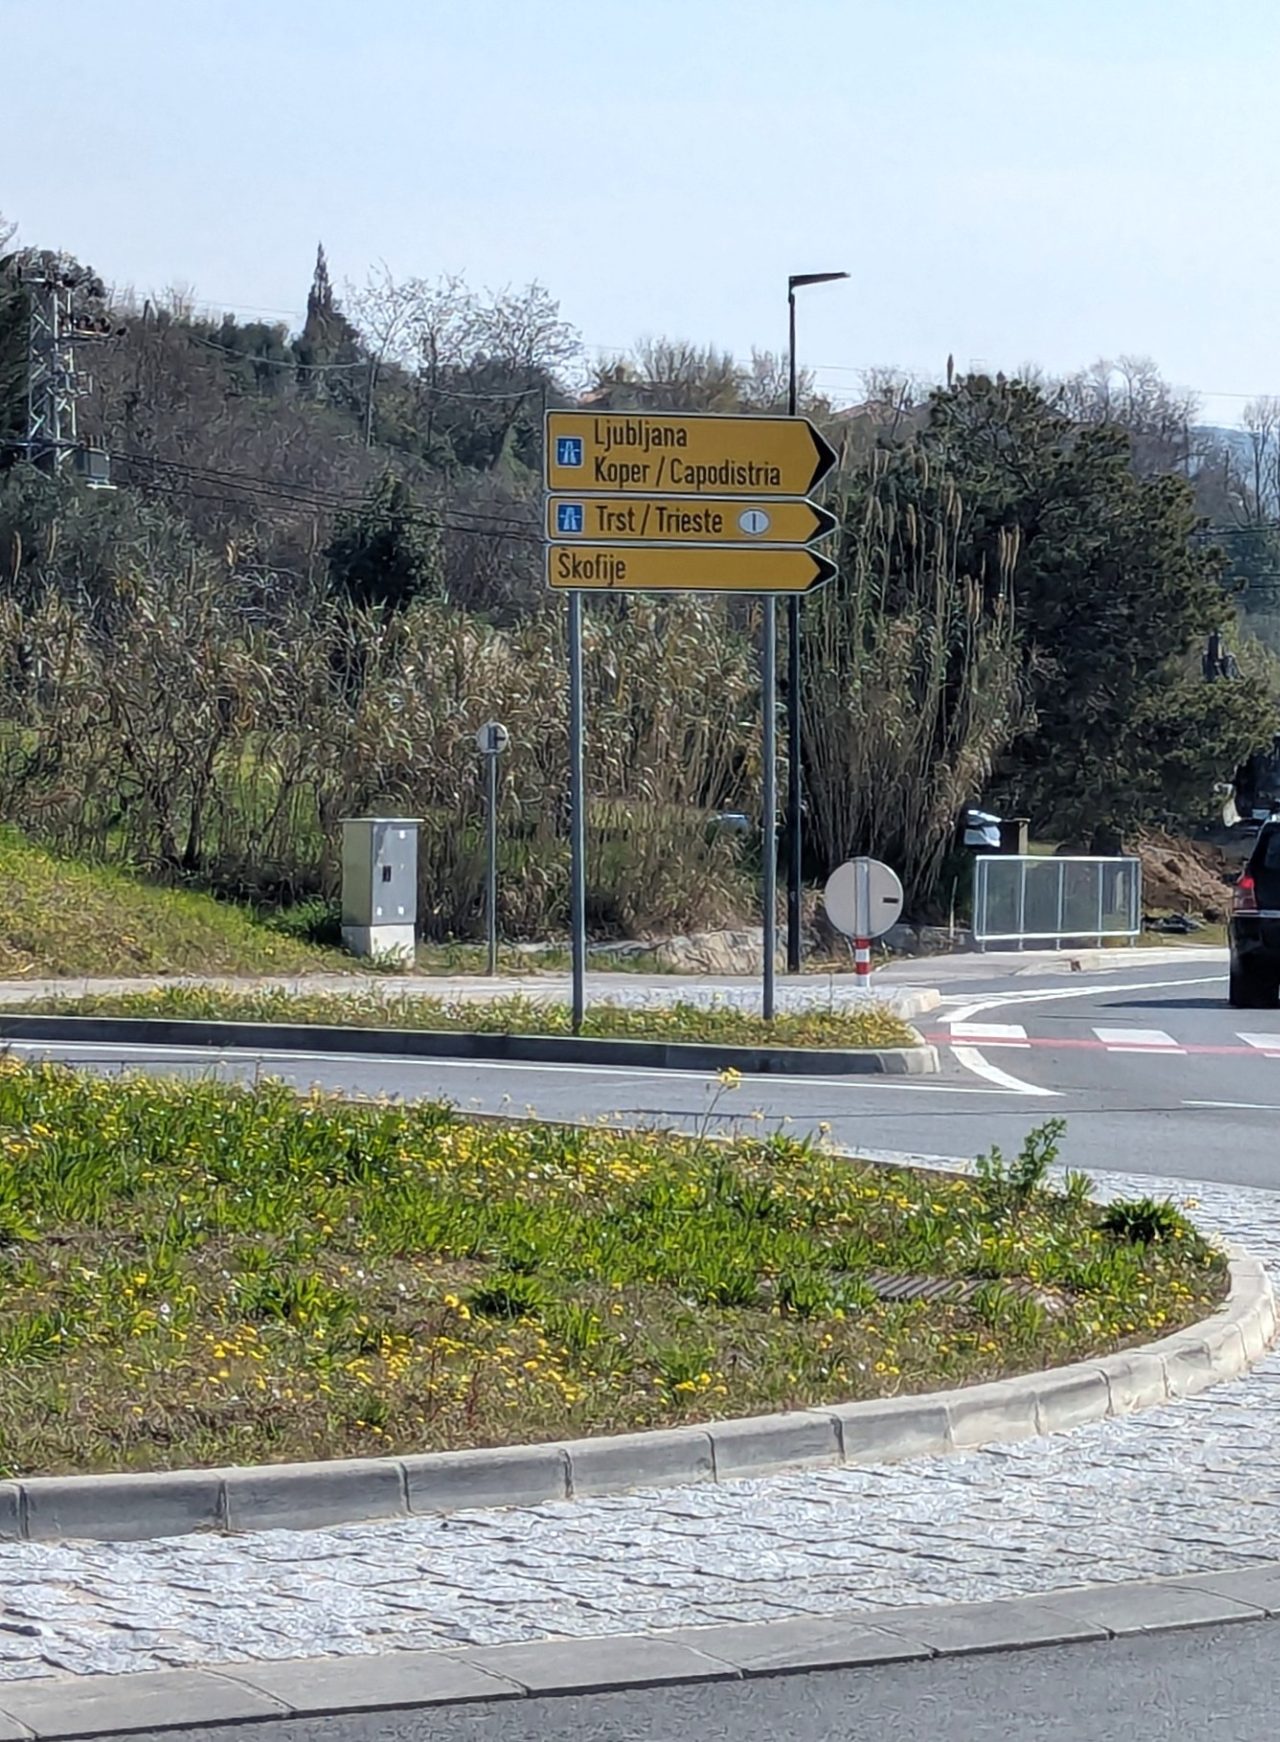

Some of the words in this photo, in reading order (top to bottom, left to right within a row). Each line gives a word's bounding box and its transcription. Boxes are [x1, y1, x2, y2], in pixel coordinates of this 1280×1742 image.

[594, 419, 688, 452] Ljubljana
[594, 456, 650, 488] Koper
[670, 458, 781, 490] Capodistria
[596, 505, 636, 532] Trst
[655, 506, 723, 533] Trieste
[557, 547, 627, 586] Škofije
